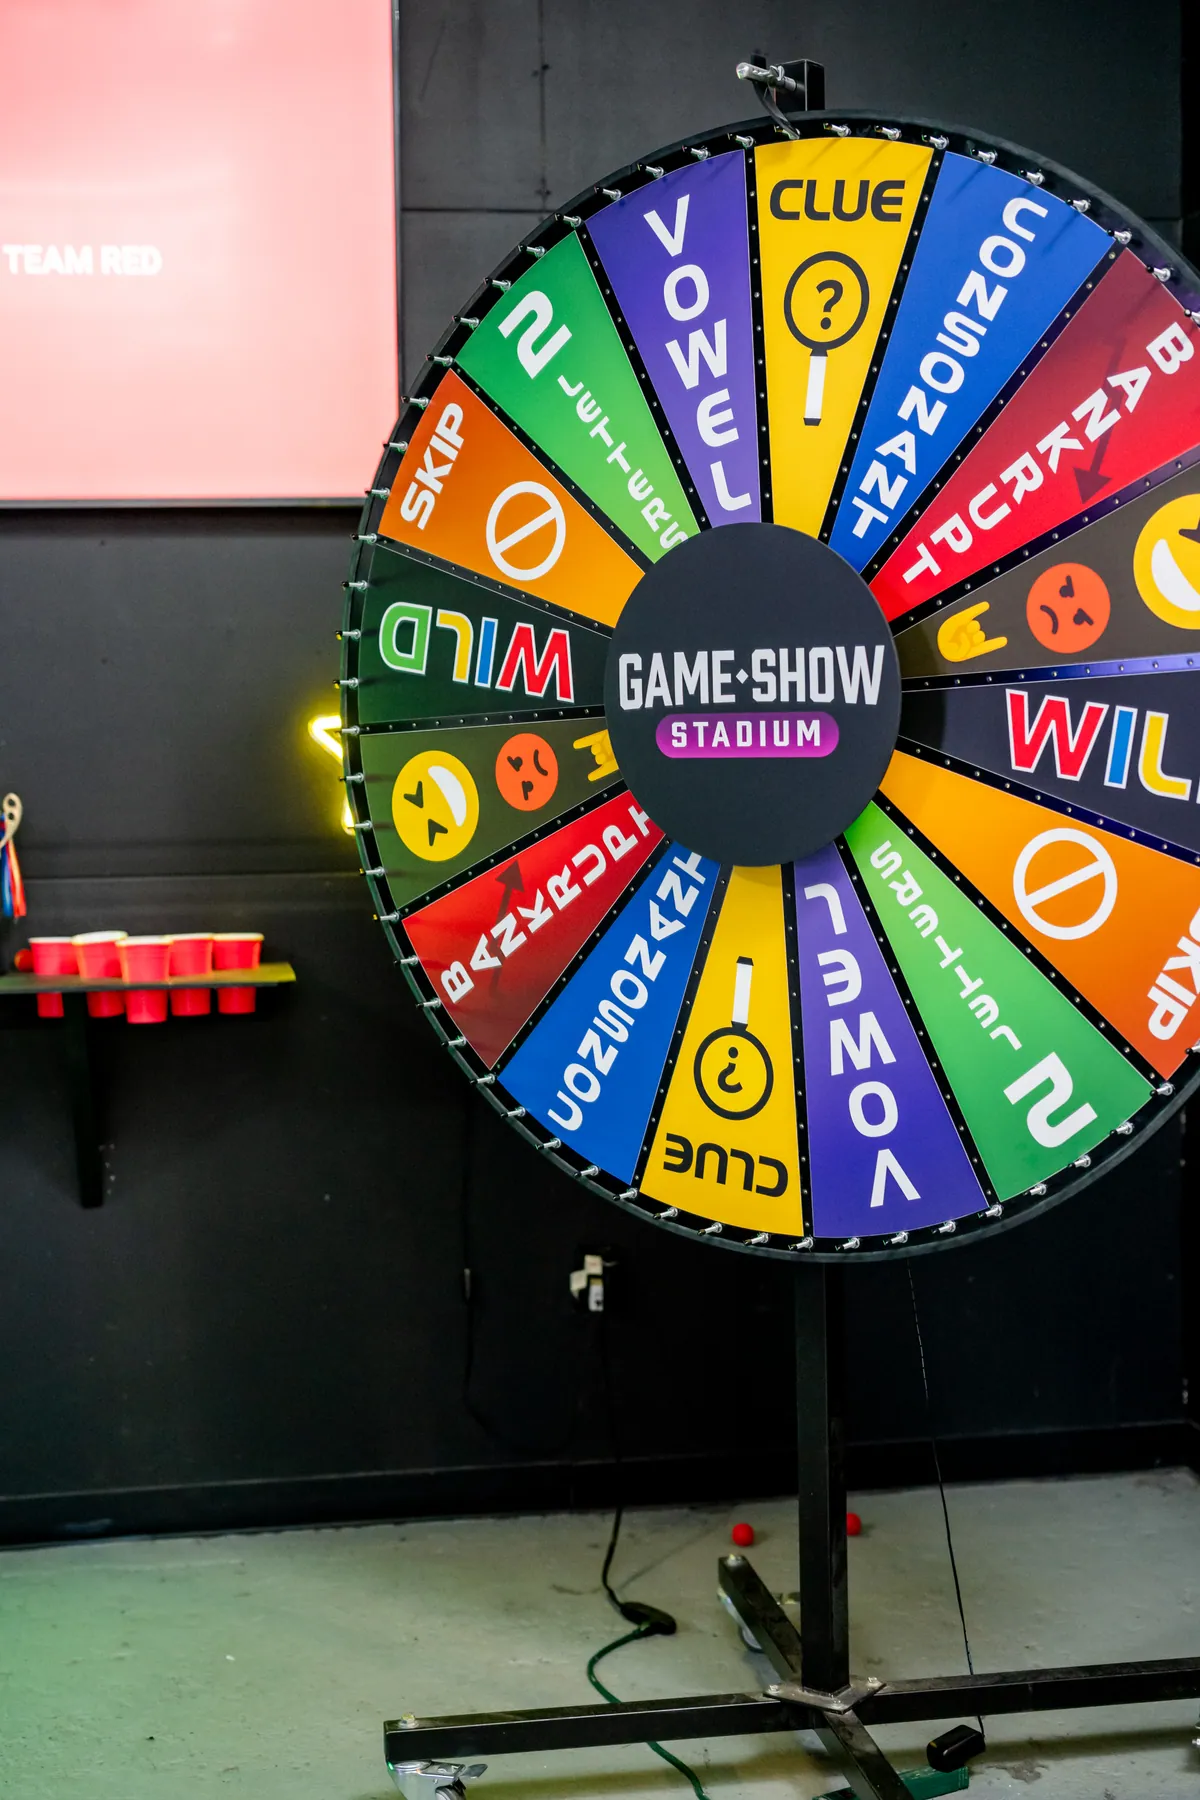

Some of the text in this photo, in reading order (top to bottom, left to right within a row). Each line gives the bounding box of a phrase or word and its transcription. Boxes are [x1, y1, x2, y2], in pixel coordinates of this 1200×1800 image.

[2, 243, 163, 276] TEAM RED
[769, 178, 906, 222] CLUE
[497, 290, 689, 550] 2 LETTERS
[643, 193, 752, 512] VOWEL
[852, 196, 1048, 540] CONSONANT
[400, 402, 465, 531] SKIP
[901, 320, 1196, 585] BANKRUPT
[378, 601, 575, 704] WILD
[671, 719, 822, 748] STADIUM
[1005, 688, 1200, 804] WIL
[440, 805, 651, 1005] BANKRUPT
[1147, 906, 1200, 1041] KIP
[547, 850, 707, 1132] CONSONANT
[803, 882, 922, 1209] VOWEL
[869, 839, 1099, 1149] 2 LETTERS
[663, 1132, 790, 1199] CLUE
